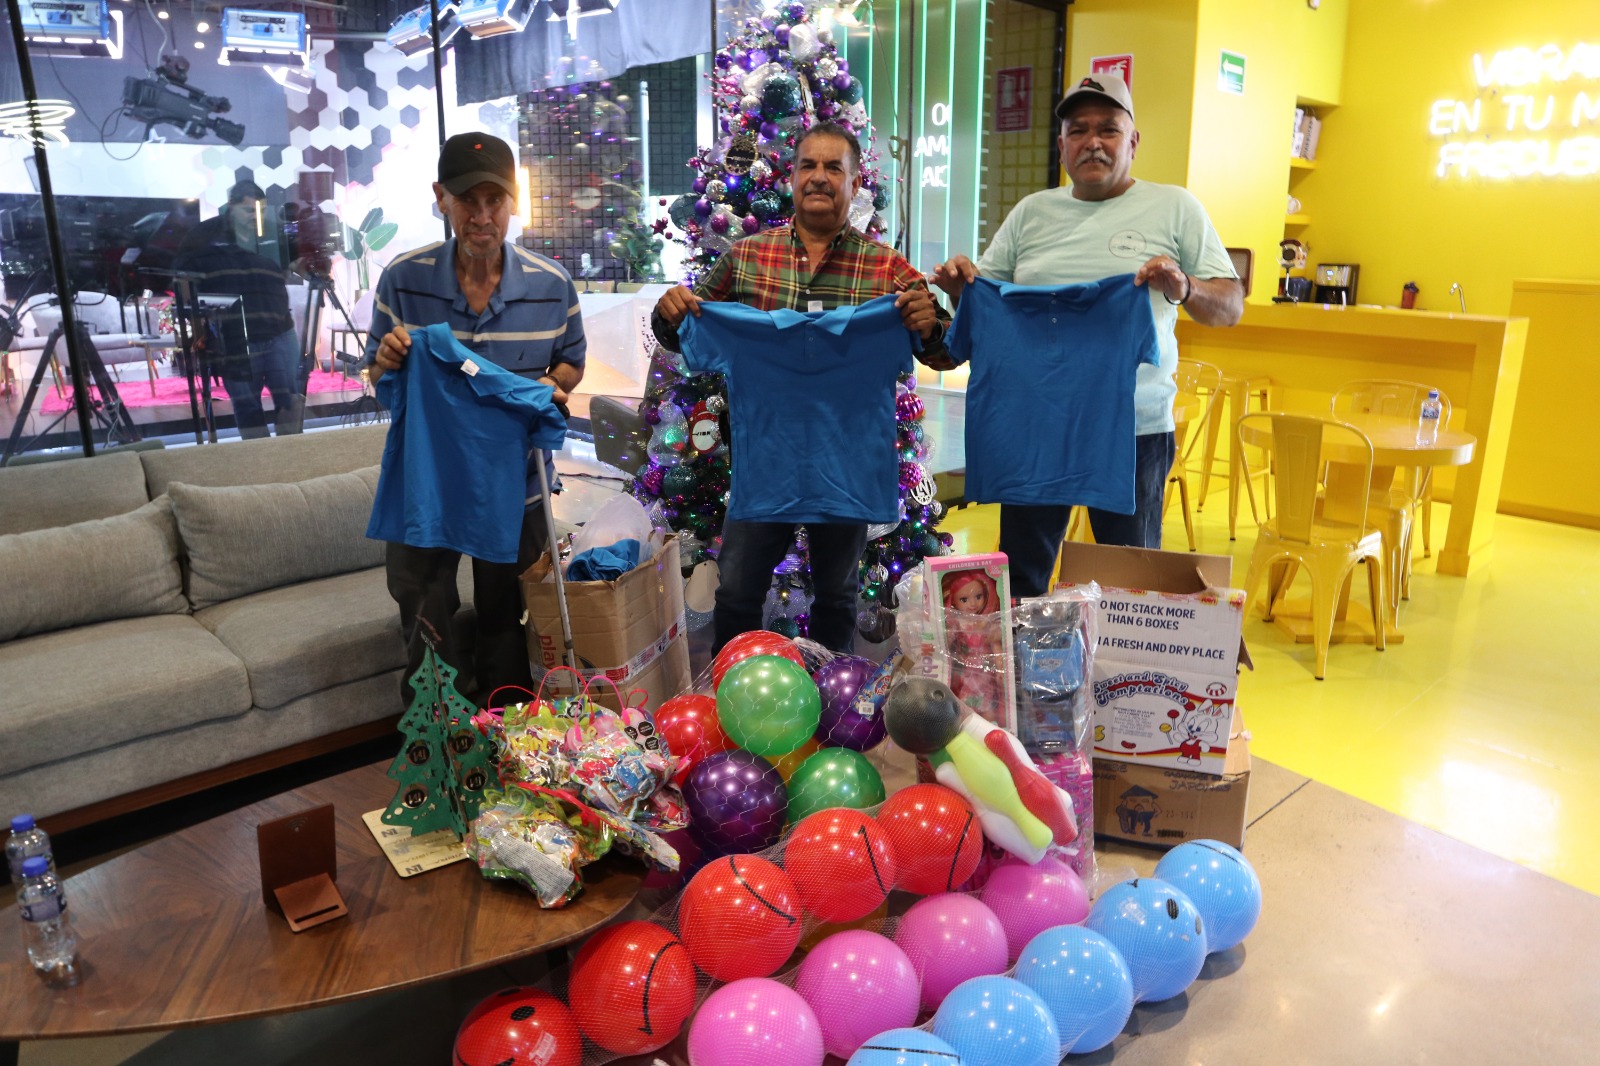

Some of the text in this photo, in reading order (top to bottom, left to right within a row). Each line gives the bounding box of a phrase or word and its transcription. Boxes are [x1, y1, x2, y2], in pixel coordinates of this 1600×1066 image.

[1430, 99, 1481, 134] EN
[1502, 95, 1554, 131] TU
[1100, 600, 1196, 620] O NOT STACK MORE
[1106, 613, 1180, 631] THAN 6 BOXES
[1102, 637, 1110, 647] A
[1112, 637, 1144, 651] FRESH
[1145, 640, 1167, 654] AND
[1168, 644, 1191, 656] DRY
[1192, 647, 1226, 660] PLACE
[1094, 671, 1189, 694] Sweet and Spicy
[1095, 684, 1188, 706] Temptations
